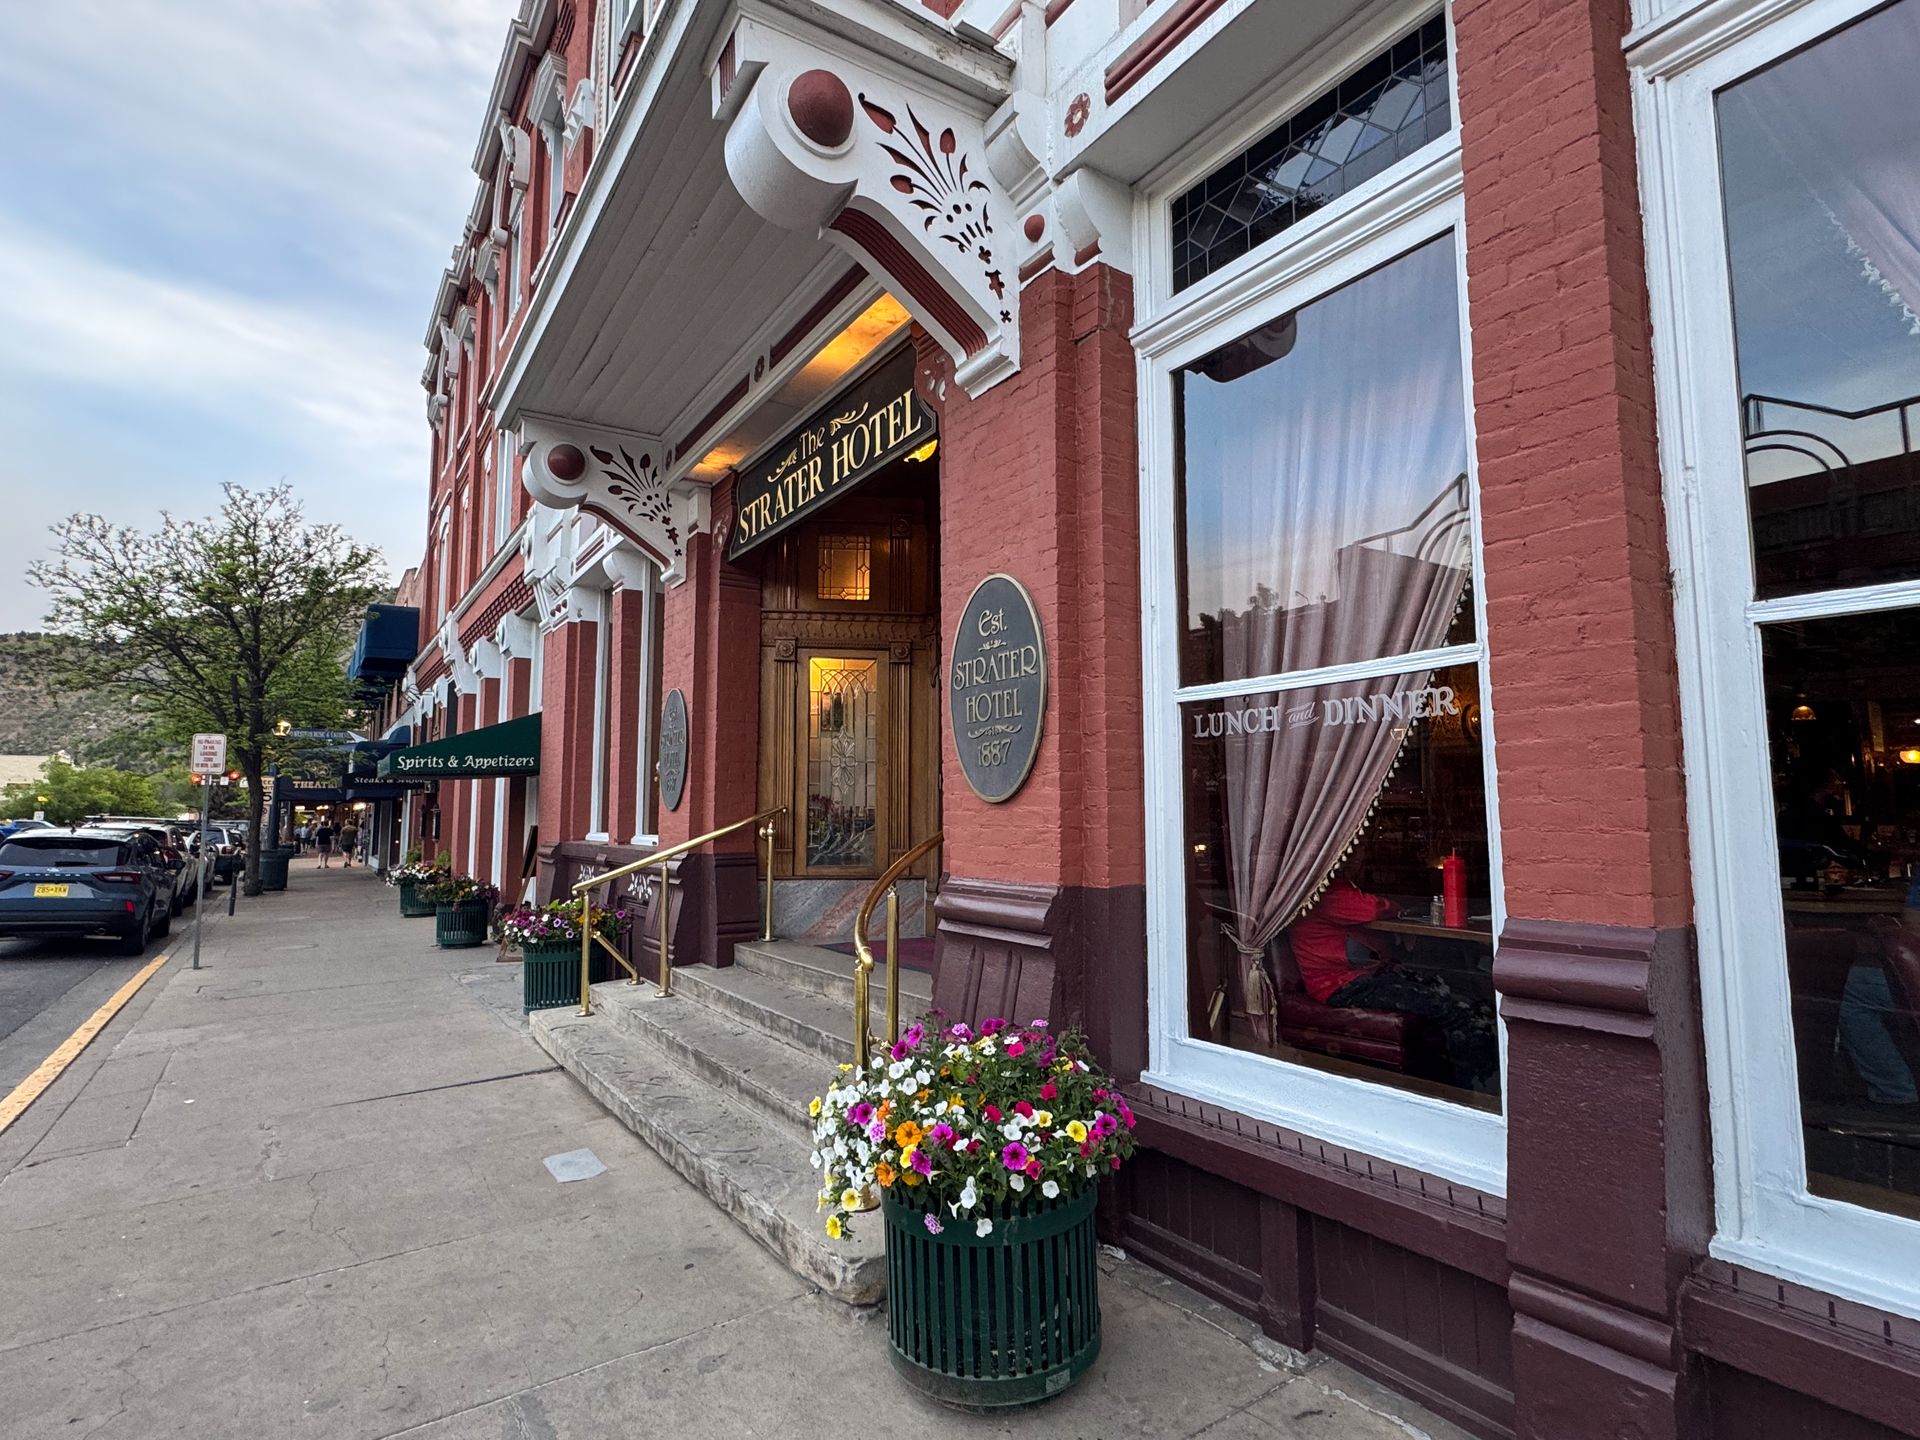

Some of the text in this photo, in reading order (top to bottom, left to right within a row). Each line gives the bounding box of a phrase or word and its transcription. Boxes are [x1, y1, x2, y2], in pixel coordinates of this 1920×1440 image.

[799, 425, 826, 461] The
[738, 388, 922, 544] STRATER HOTEL
[978, 608, 1008, 637] Est.
[953, 644, 1038, 691] STRATER
[965, 687, 1023, 725] HOTEL
[1193, 685, 1459, 739] LUNCH and DINNER
[397, 754, 535, 771] Spirits & Appetizers
[976, 738, 1012, 768] 1887
